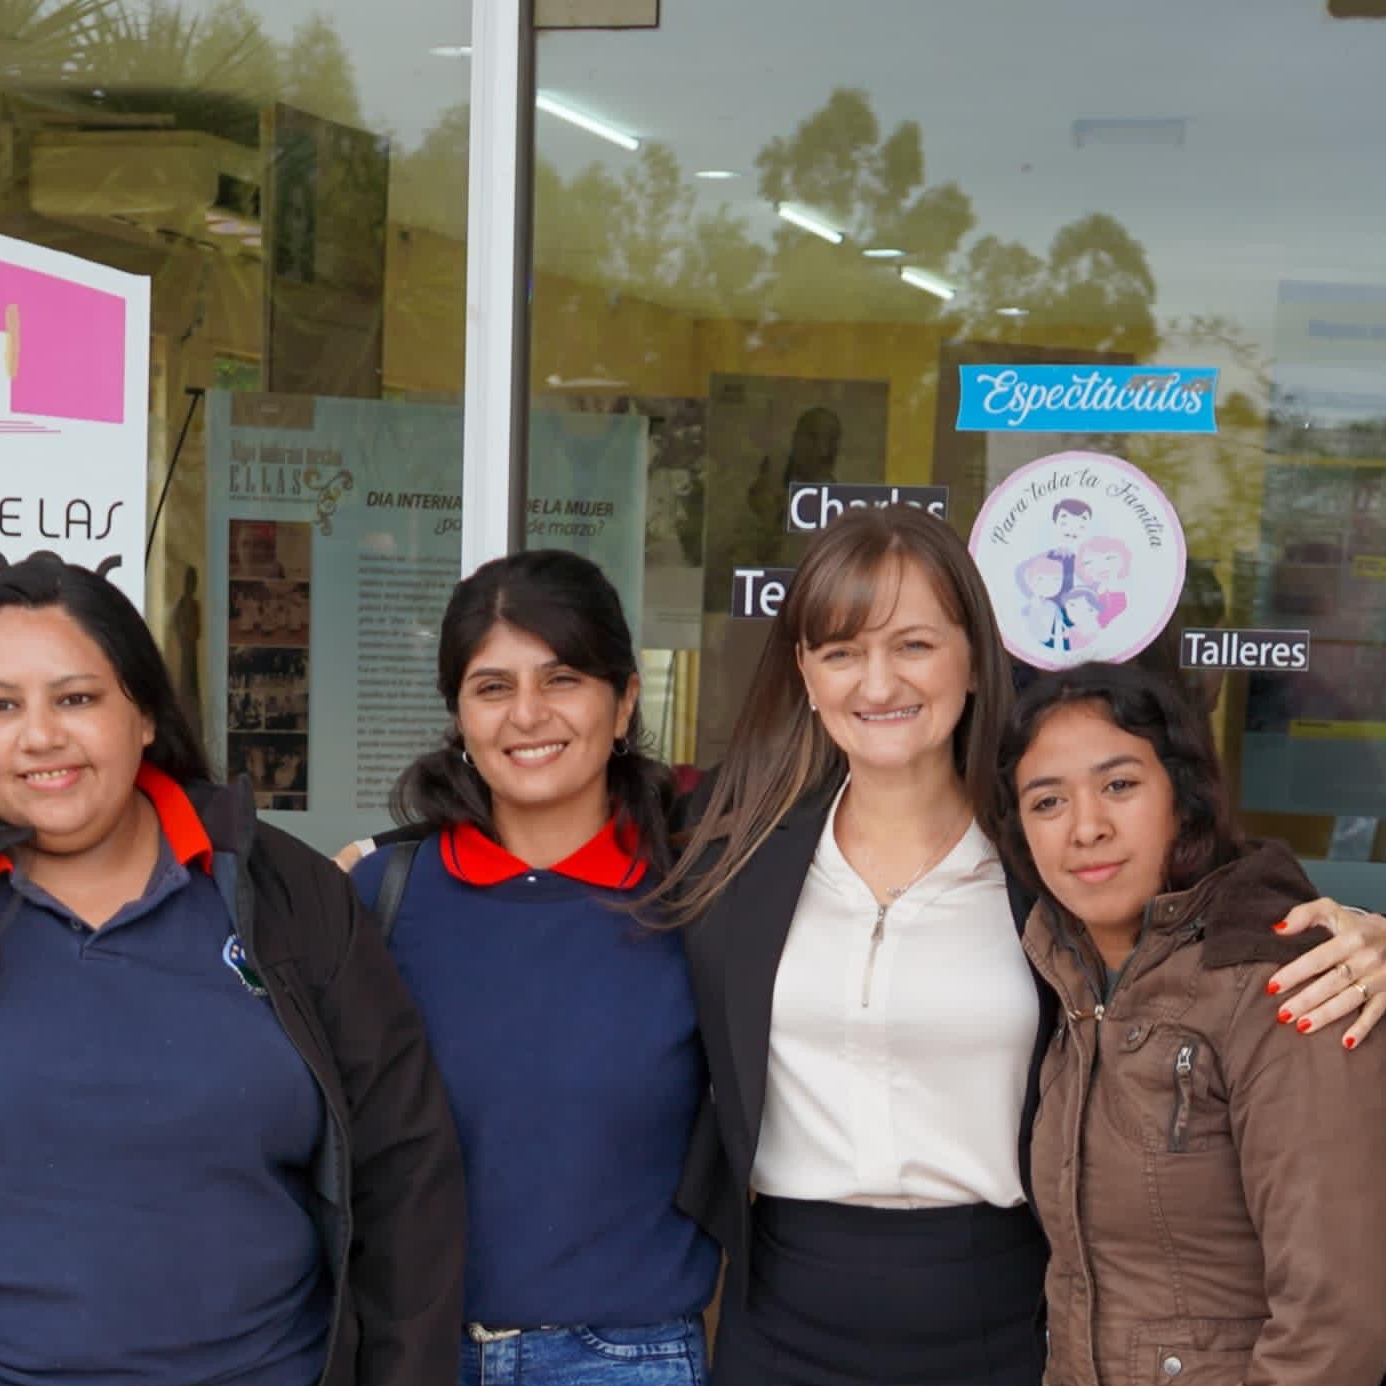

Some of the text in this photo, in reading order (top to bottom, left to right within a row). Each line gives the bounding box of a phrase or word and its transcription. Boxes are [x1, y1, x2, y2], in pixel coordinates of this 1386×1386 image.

[977, 370, 1205, 427] Espectáculos
[39, 498, 124, 541] LAS
[366, 491, 395, 508] DIA
[396, 493, 463, 511] INTERNA
[564, 500, 615, 517] MUJER
[990, 466, 1165, 549] Para toda la Familia
[1185, 632, 1307, 668] Talleres
